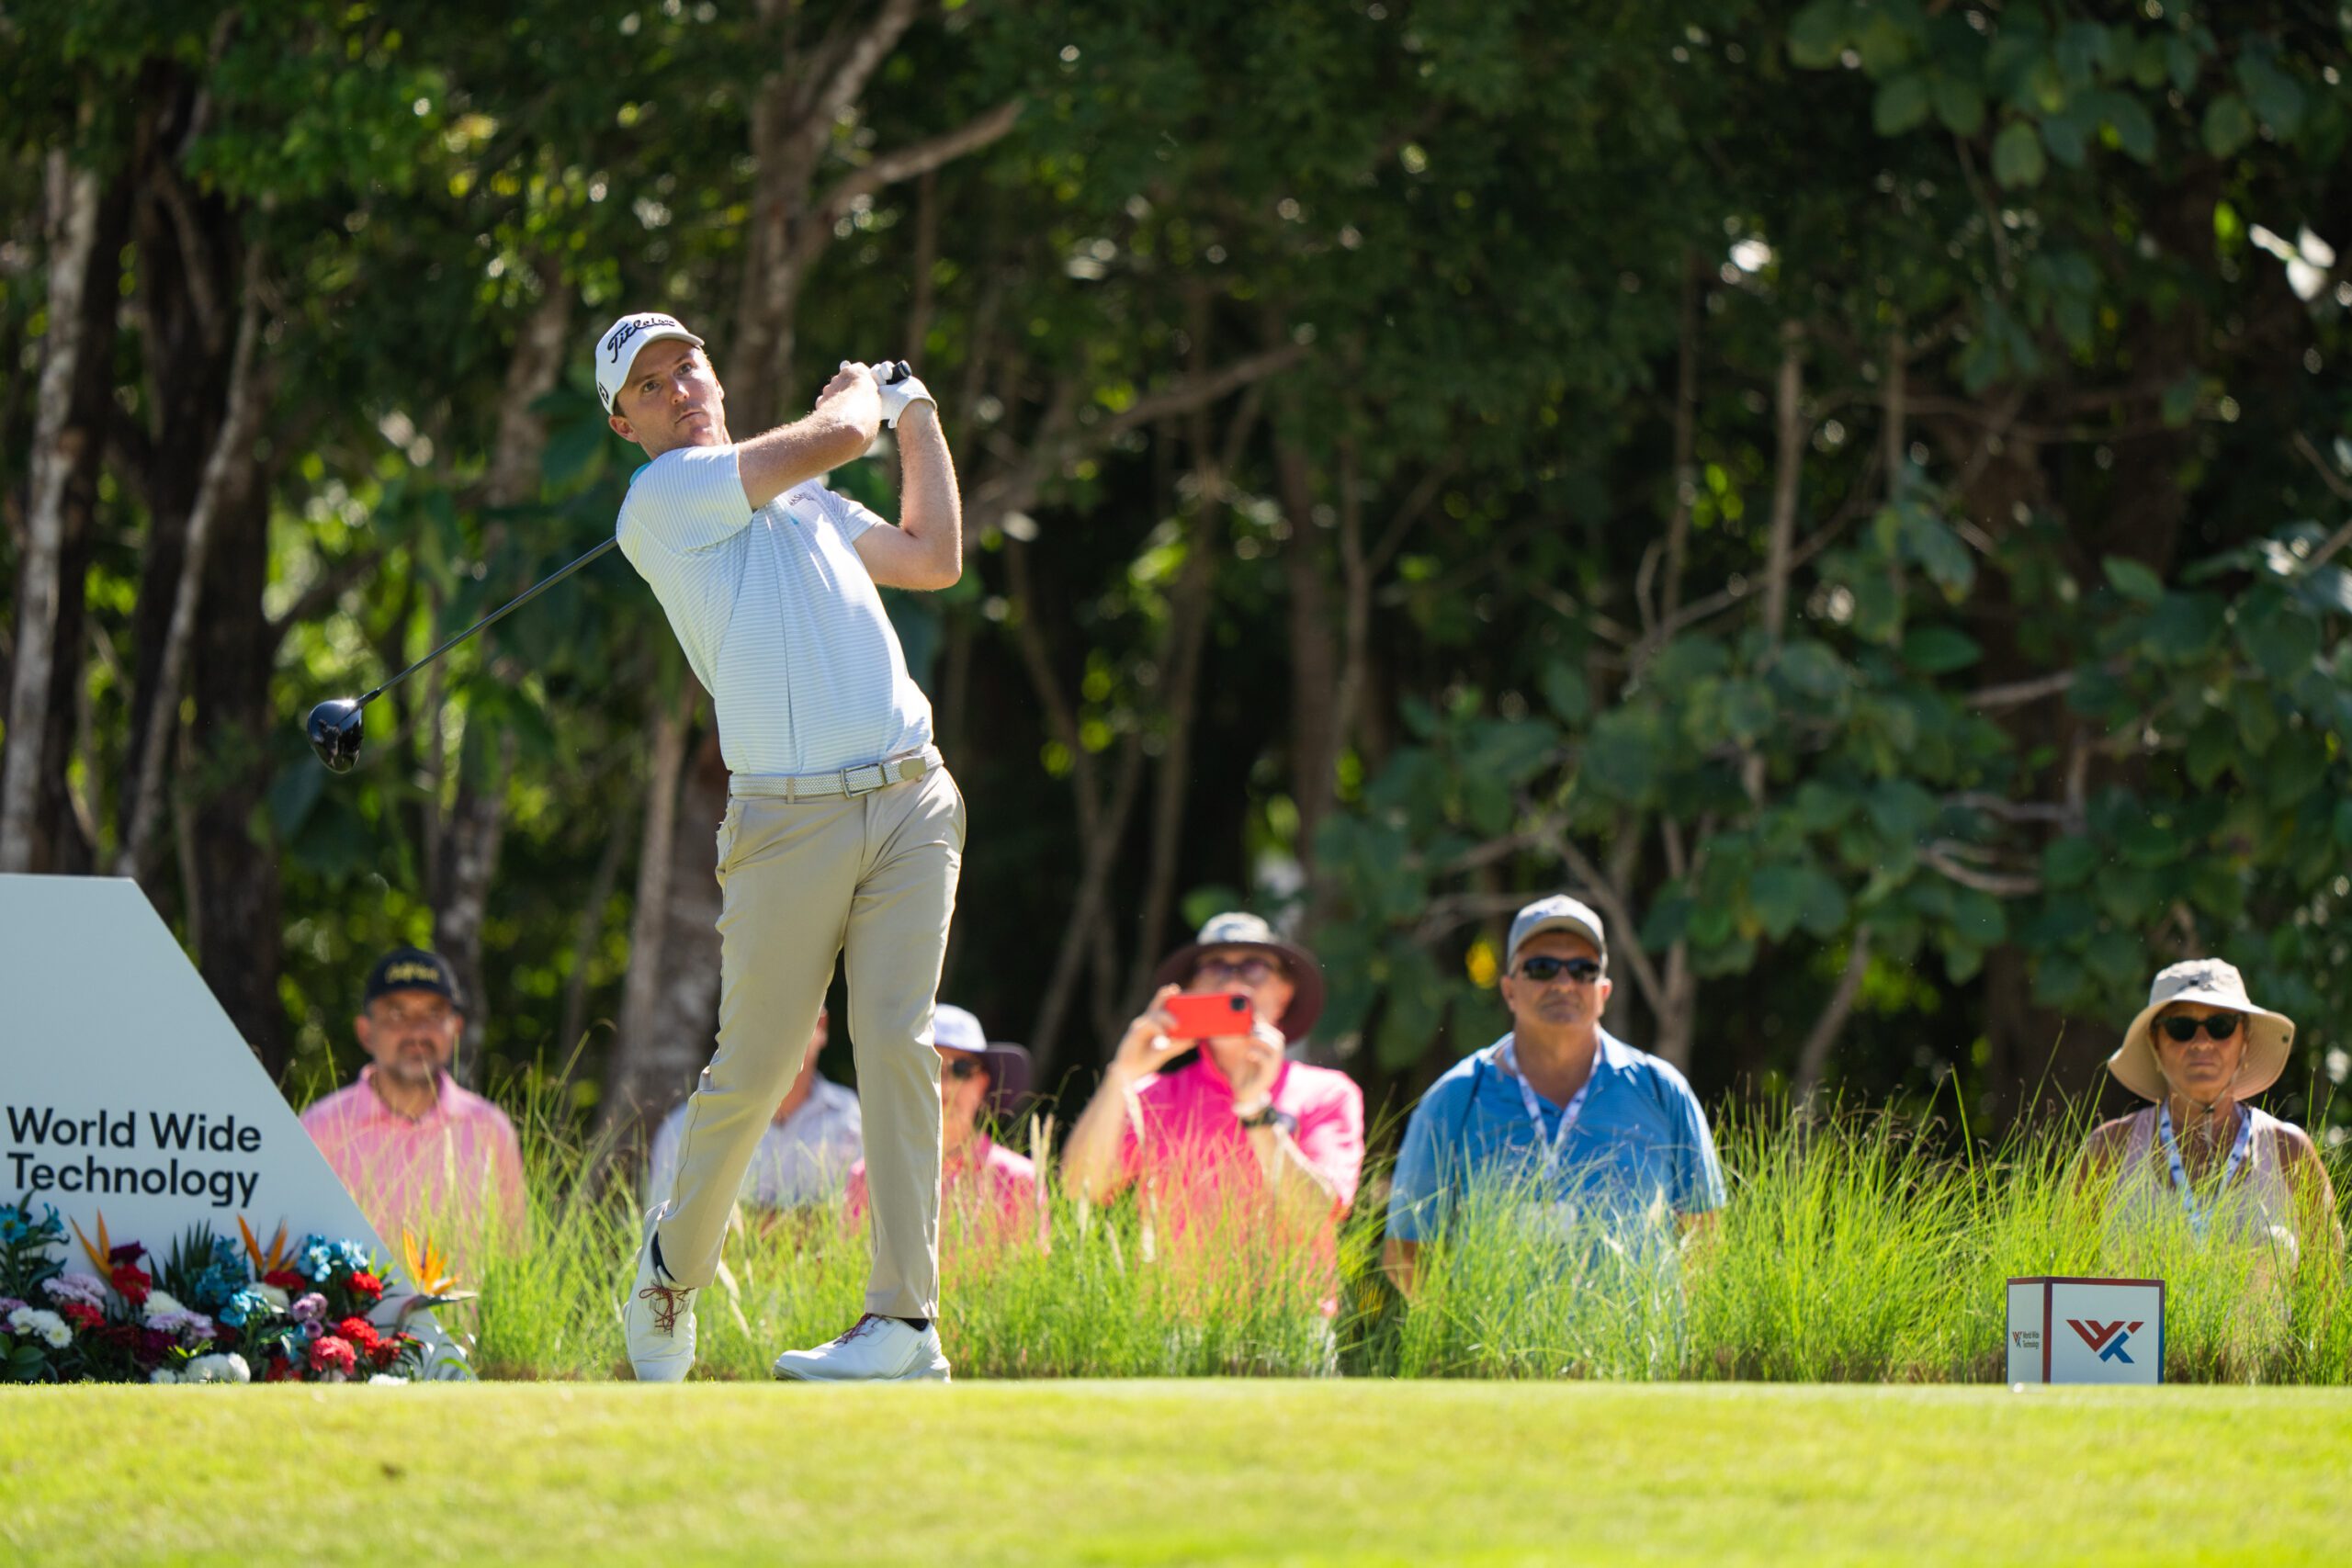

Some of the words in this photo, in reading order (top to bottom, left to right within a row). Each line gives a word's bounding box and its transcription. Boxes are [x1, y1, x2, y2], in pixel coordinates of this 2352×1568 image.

[6, 1106, 136, 1148] World
[149, 1111, 262, 1153] Wide
[6, 1152, 259, 1209] Technology
